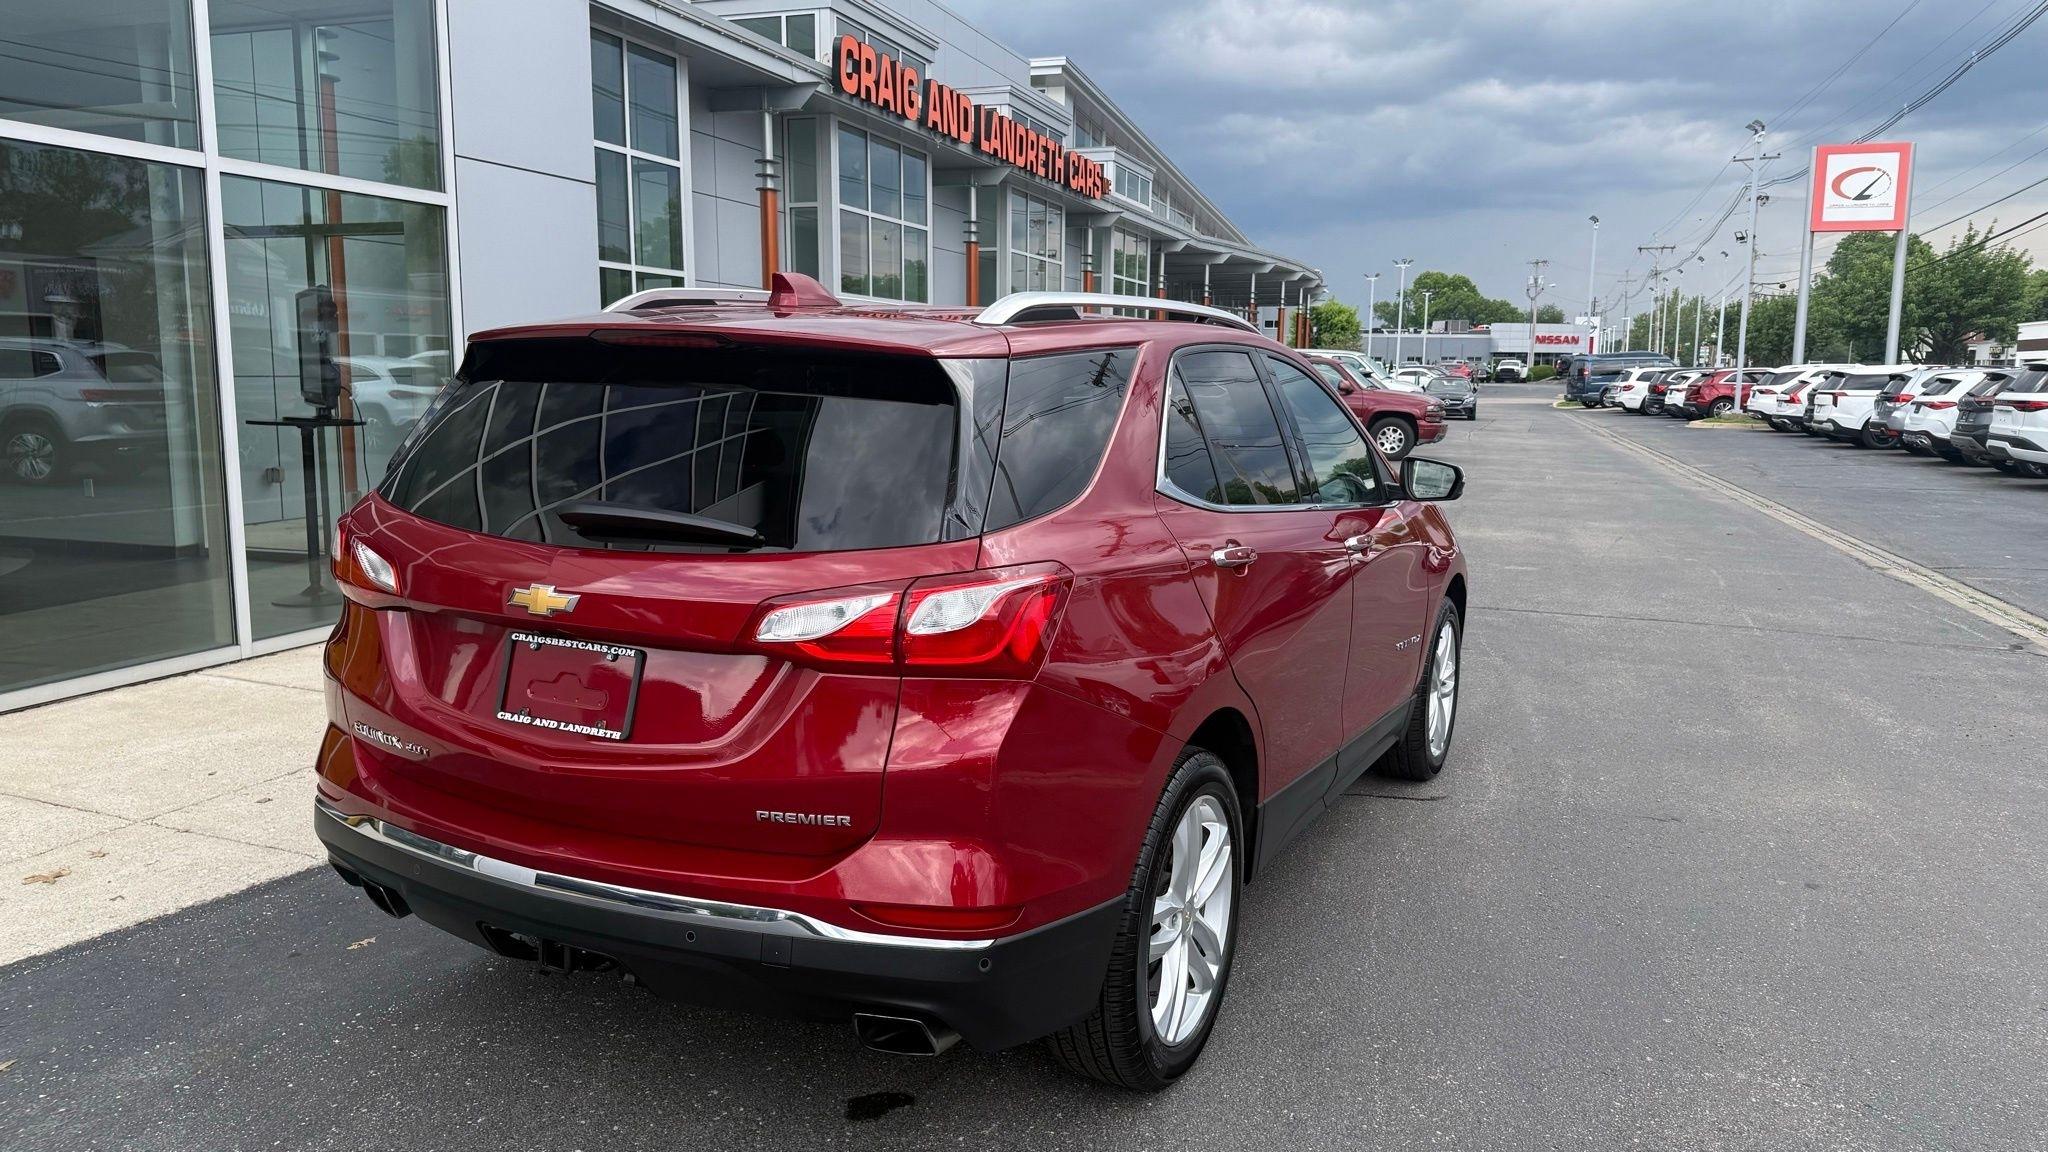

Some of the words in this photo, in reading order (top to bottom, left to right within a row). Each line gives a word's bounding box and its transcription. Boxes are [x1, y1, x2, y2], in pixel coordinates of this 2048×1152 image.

[836, 34, 919, 121] CRAIG
[924, 78, 973, 144] AND
[976, 104, 1064, 185] LANDRETH
[1064, 151, 1102, 200] CARS
[1535, 335, 1580, 345] NISSAN
[511, 632, 636, 657] CRAIGSBESTCARS.COM
[354, 721, 403, 750] EQUINOX
[497, 711, 531, 724] CRAIG
[533, 718, 558, 729] AND
[559, 722, 622, 740] LANDRETH
[756, 810, 852, 827] PREMIER
